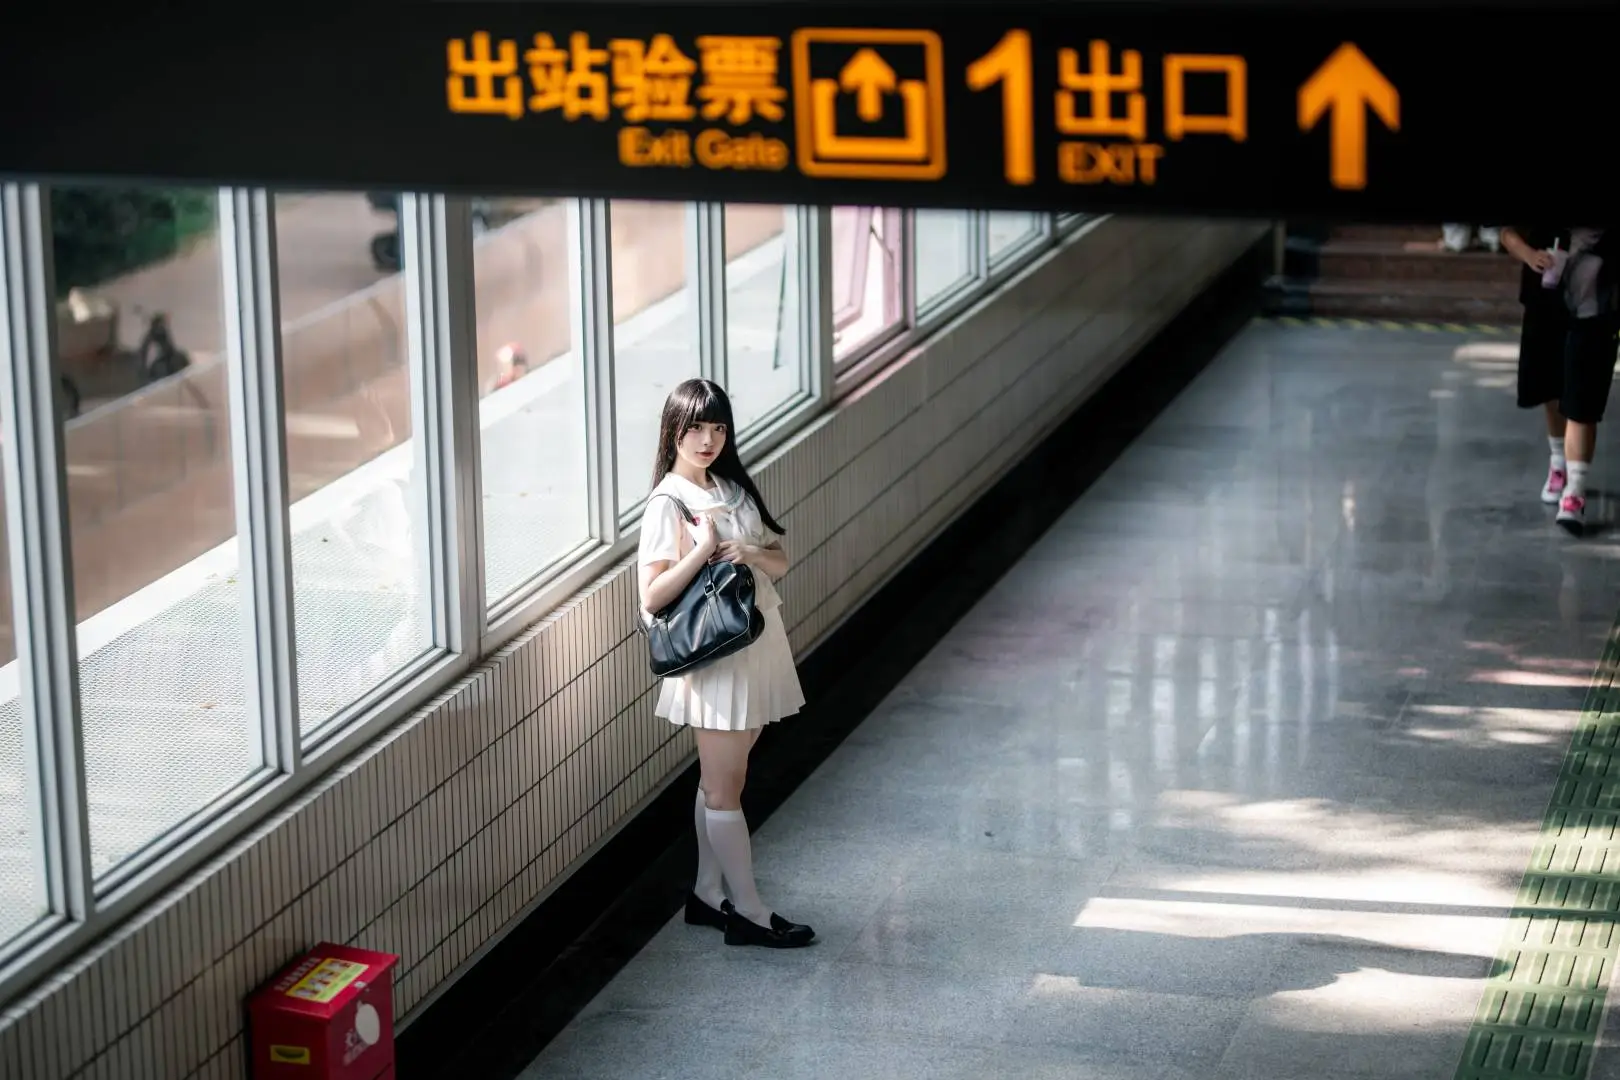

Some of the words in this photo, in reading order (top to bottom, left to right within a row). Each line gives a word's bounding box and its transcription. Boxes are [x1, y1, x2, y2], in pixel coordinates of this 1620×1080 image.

[447, 32, 786, 122] 出站验票
[966, 29, 1034, 184] 1
[1055, 40, 1247, 140] 出口
[618, 127, 691, 167] Exit
[695, 130, 788, 169] Gate
[1058, 142, 1163, 183] EXIT
